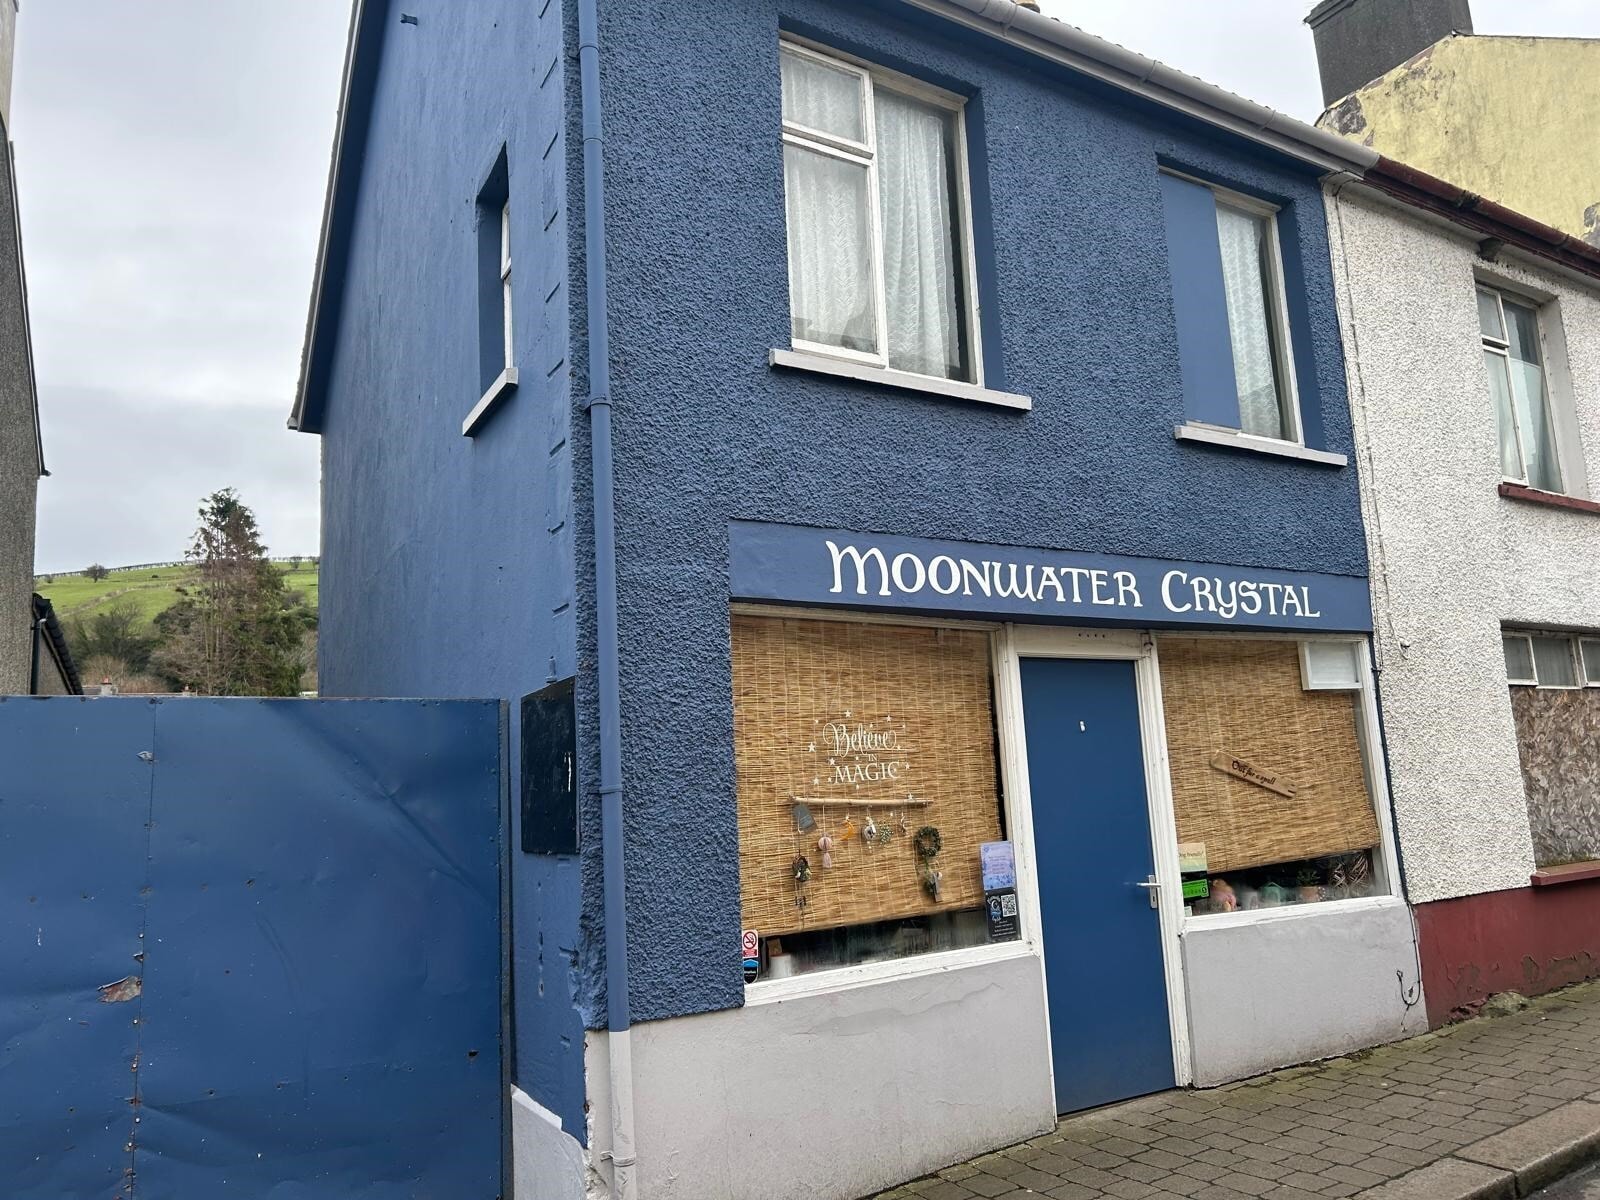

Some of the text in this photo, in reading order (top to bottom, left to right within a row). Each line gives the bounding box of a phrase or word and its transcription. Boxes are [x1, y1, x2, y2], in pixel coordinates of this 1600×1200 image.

[826, 541, 1320, 618] MOONWATER CRYSTAL
[822, 723, 897, 757] Believe
[868, 754, 878, 762] IN
[1231, 760, 1248, 773] Out
[834, 761, 900, 785] MAGIC
